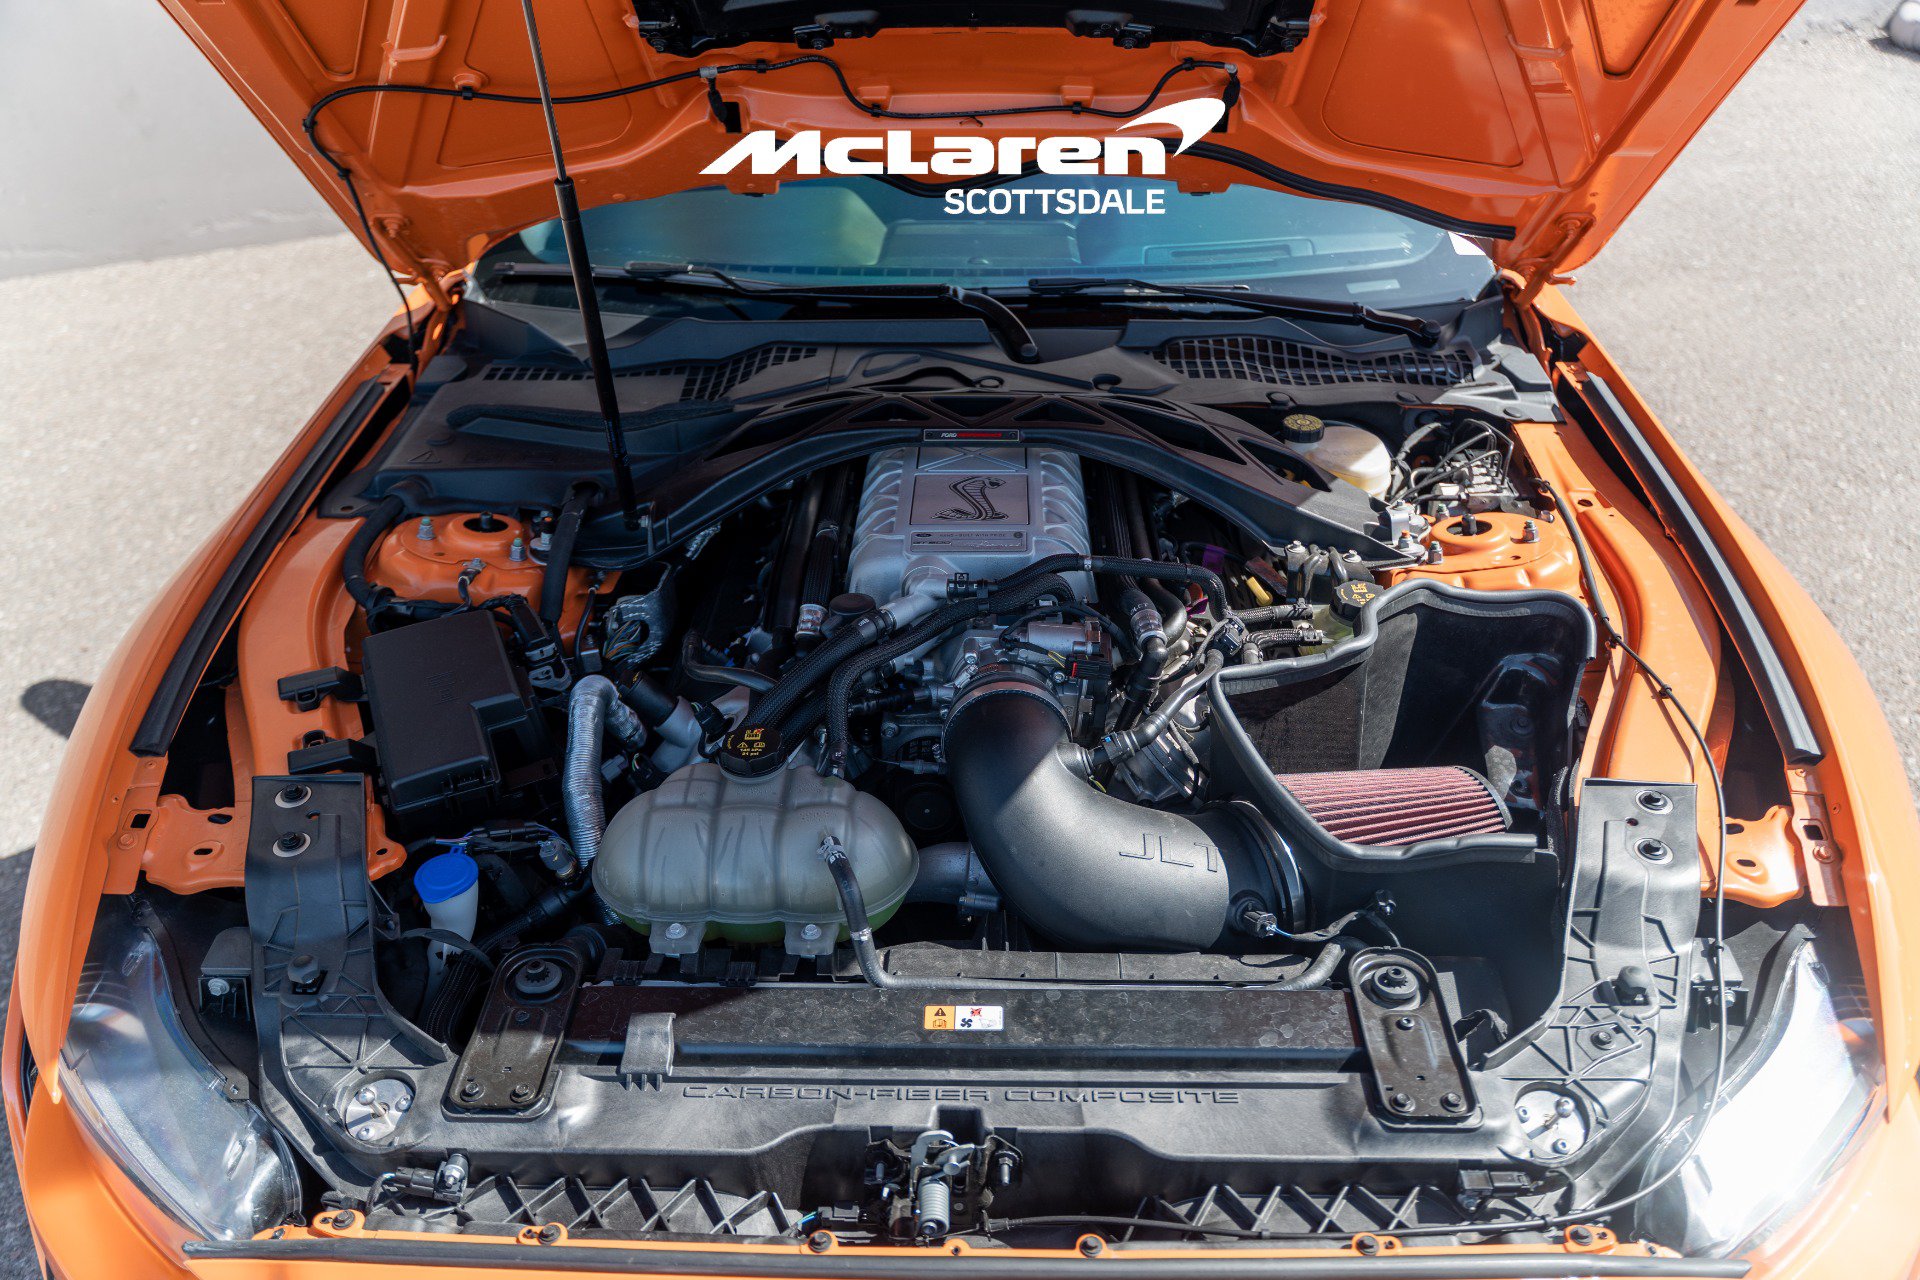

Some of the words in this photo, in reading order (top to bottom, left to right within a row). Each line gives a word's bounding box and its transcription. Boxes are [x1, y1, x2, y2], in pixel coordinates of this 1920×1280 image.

[1119, 833, 1218, 873] JLT
[682, 1085, 991, 1102] CARBON-FIBER
[1004, 1089, 1241, 1104] COMPOSITE
